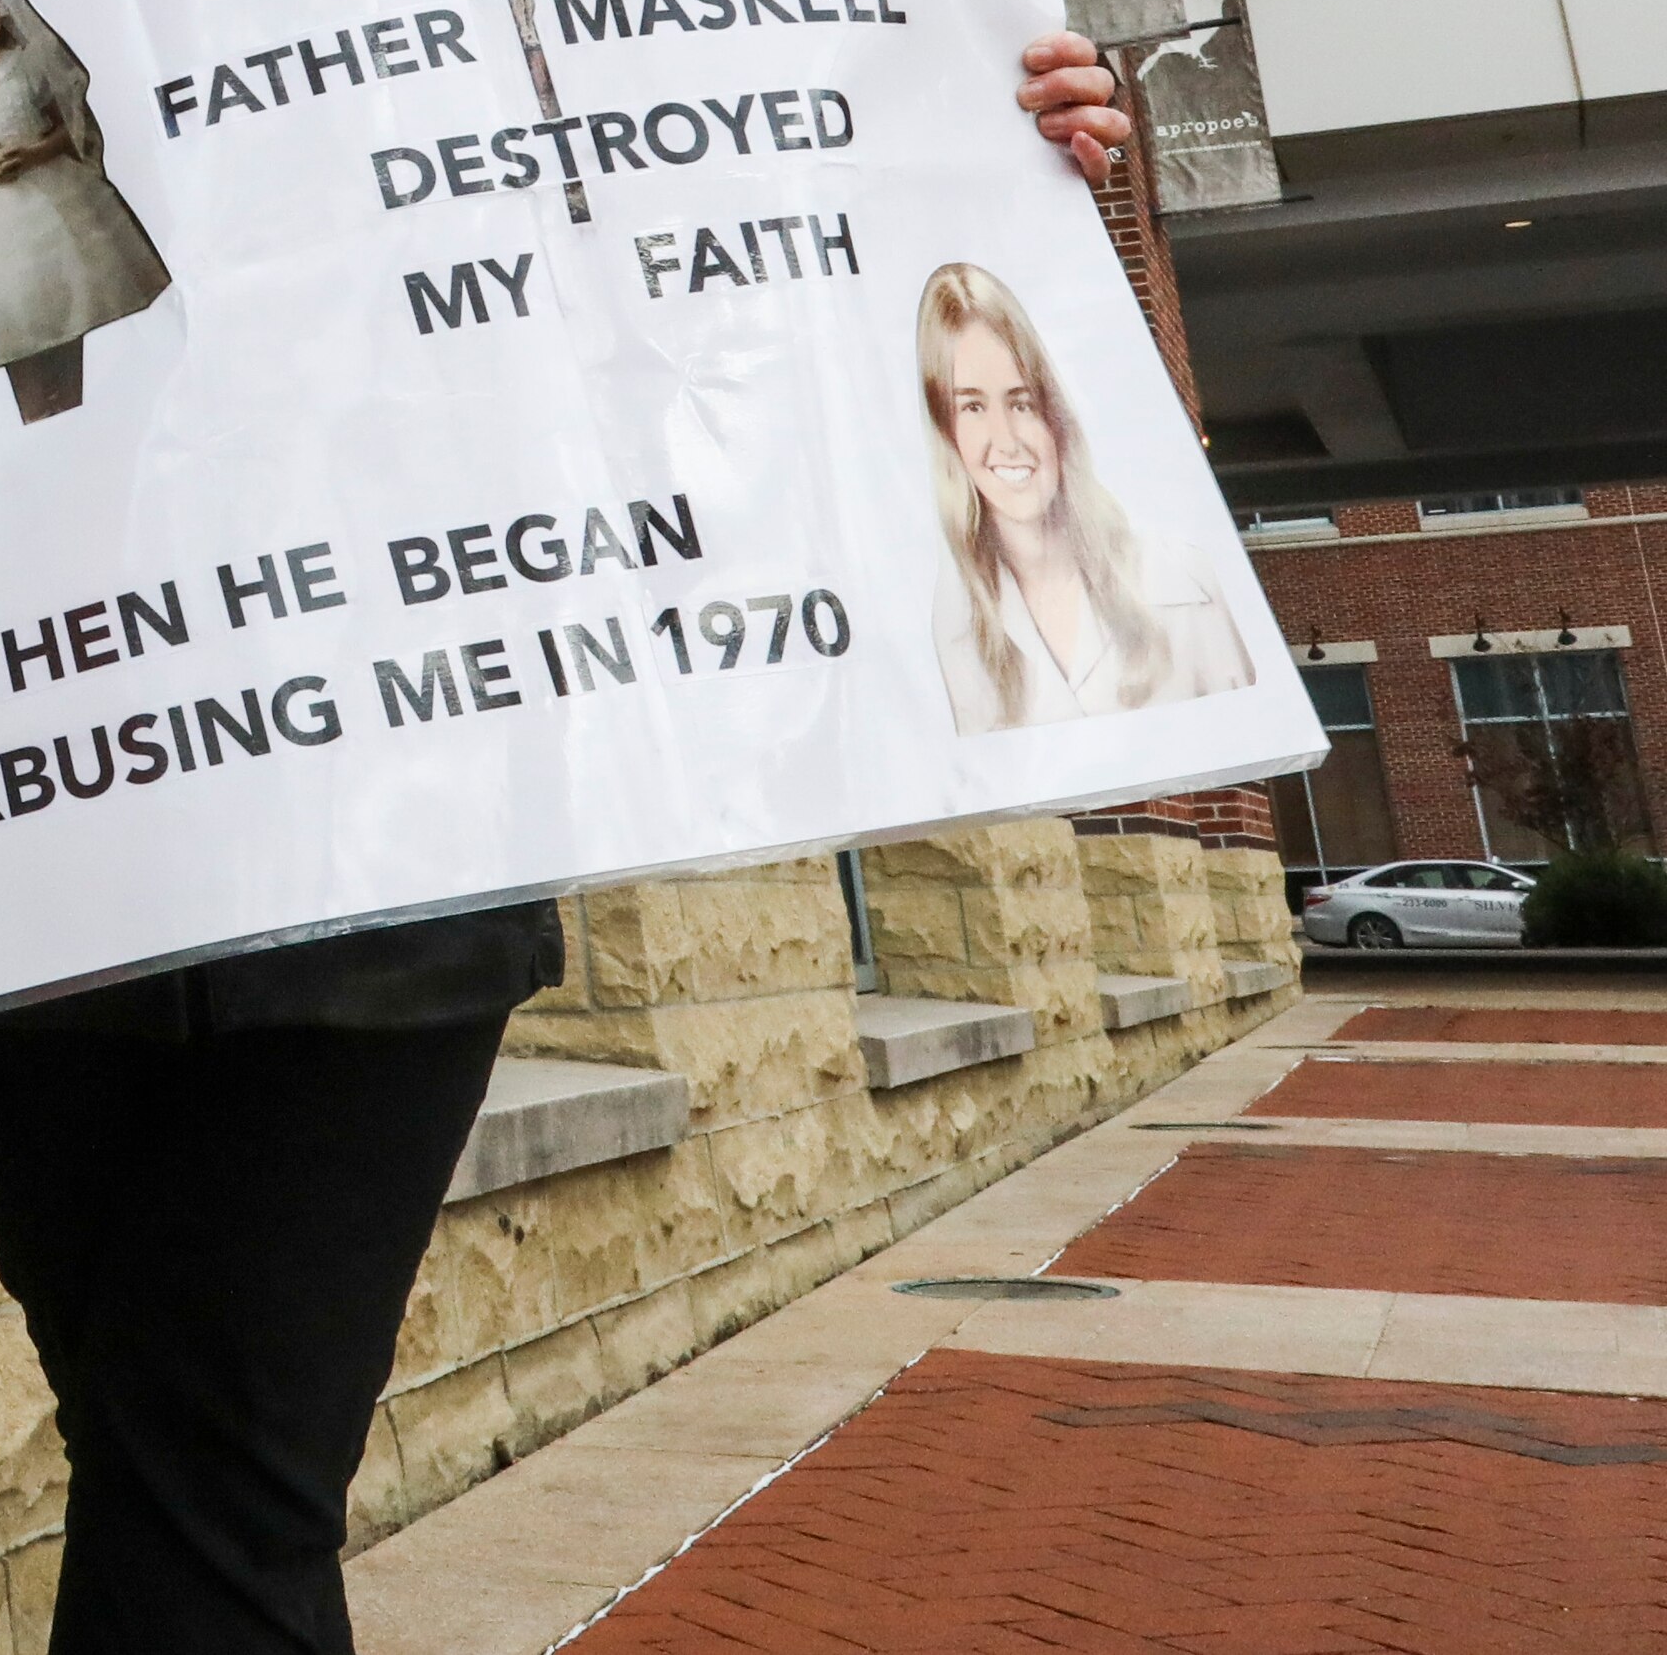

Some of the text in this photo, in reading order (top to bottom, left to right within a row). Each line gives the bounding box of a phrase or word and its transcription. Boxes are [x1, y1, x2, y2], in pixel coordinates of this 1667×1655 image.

[153, 9, 477, 140] FATHER
[370, 87, 857, 211] DESTROYED
[403, 212, 860, 335] MY FAITH
[216, 541, 348, 629] HE
[387, 492, 704, 606] BEGAN
[372, 639, 523, 729] ME
[537, 617, 635, 697] IN
[652, 588, 851, 675] 1970
[1474, 900, 1522, 912] SILVE
